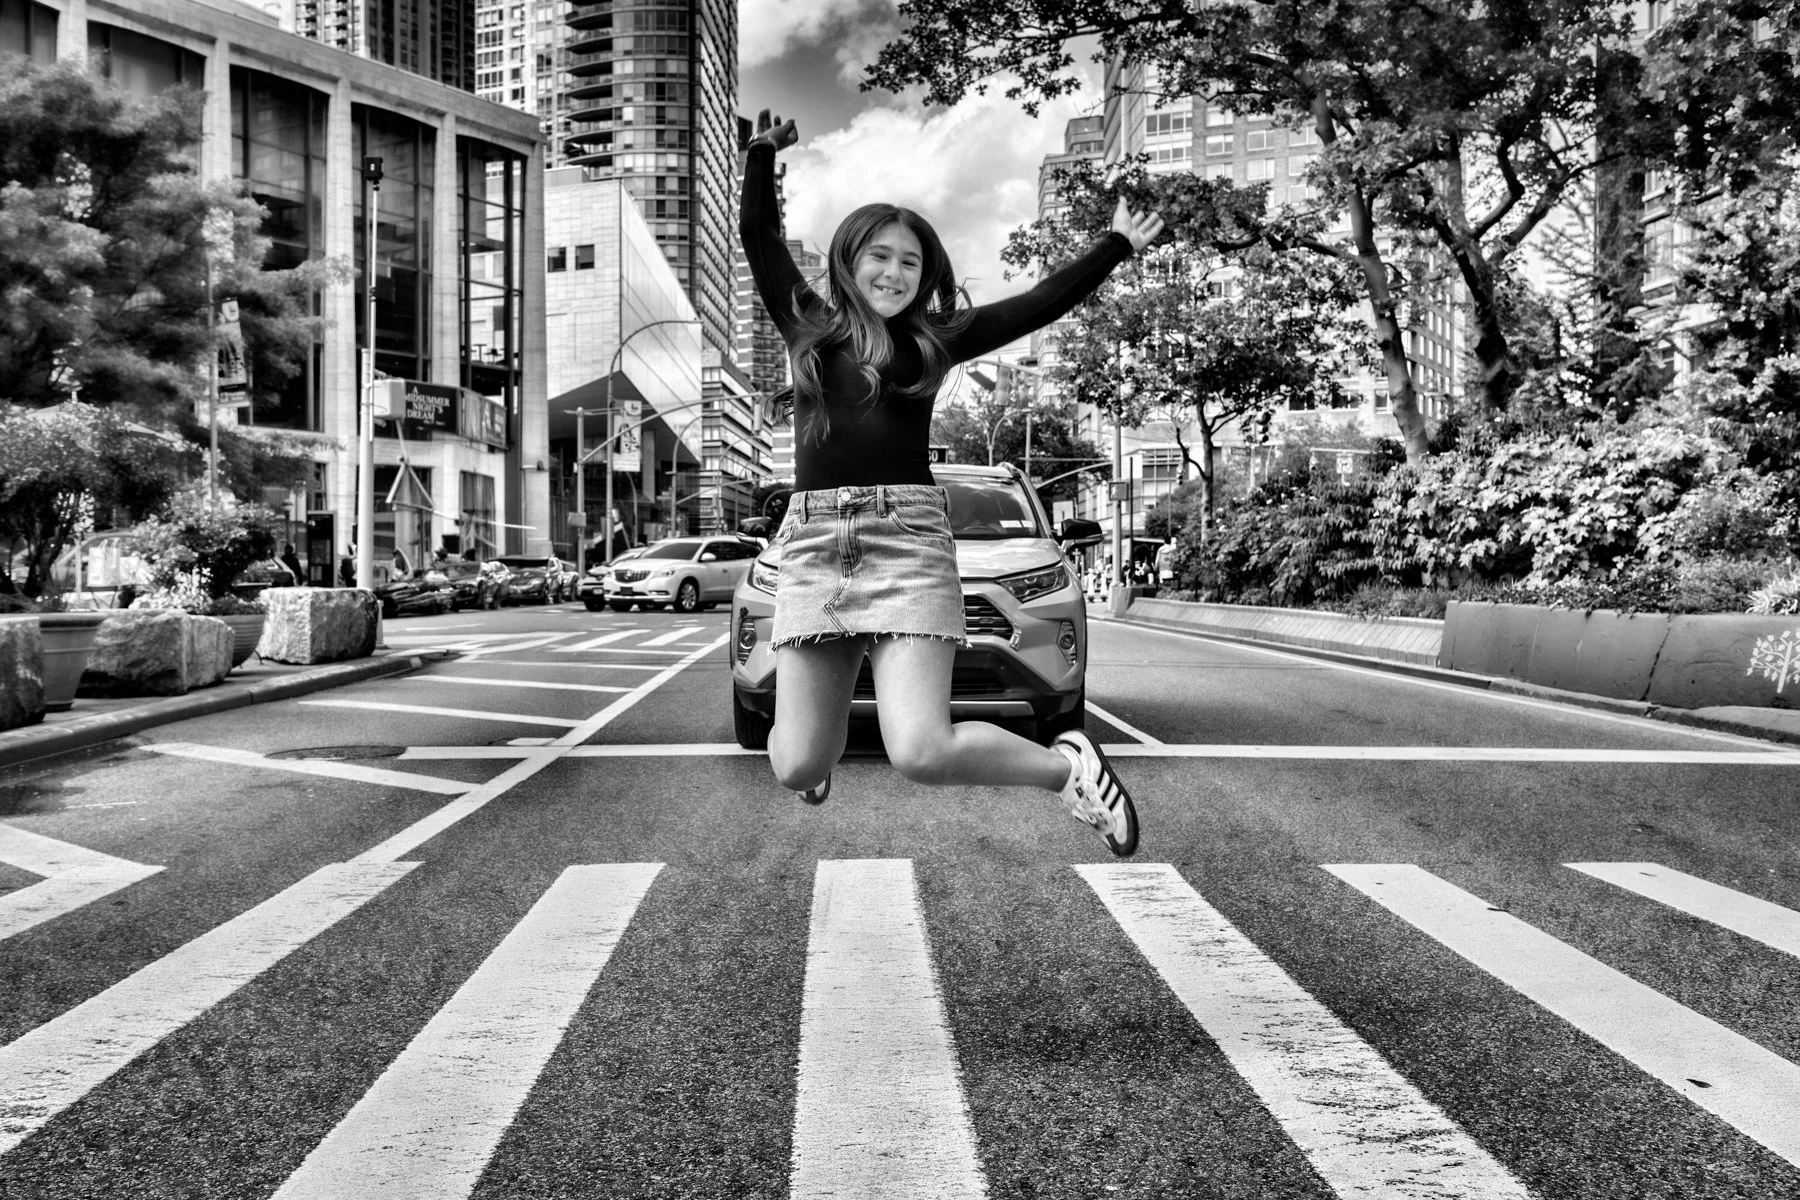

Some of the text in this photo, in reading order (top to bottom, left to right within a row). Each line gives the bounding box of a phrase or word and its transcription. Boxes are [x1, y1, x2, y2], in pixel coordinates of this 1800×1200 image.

[412, 386, 419, 395] A
[404, 393, 450, 407] MIDSUMMER
[407, 409, 435, 421] DREAM
